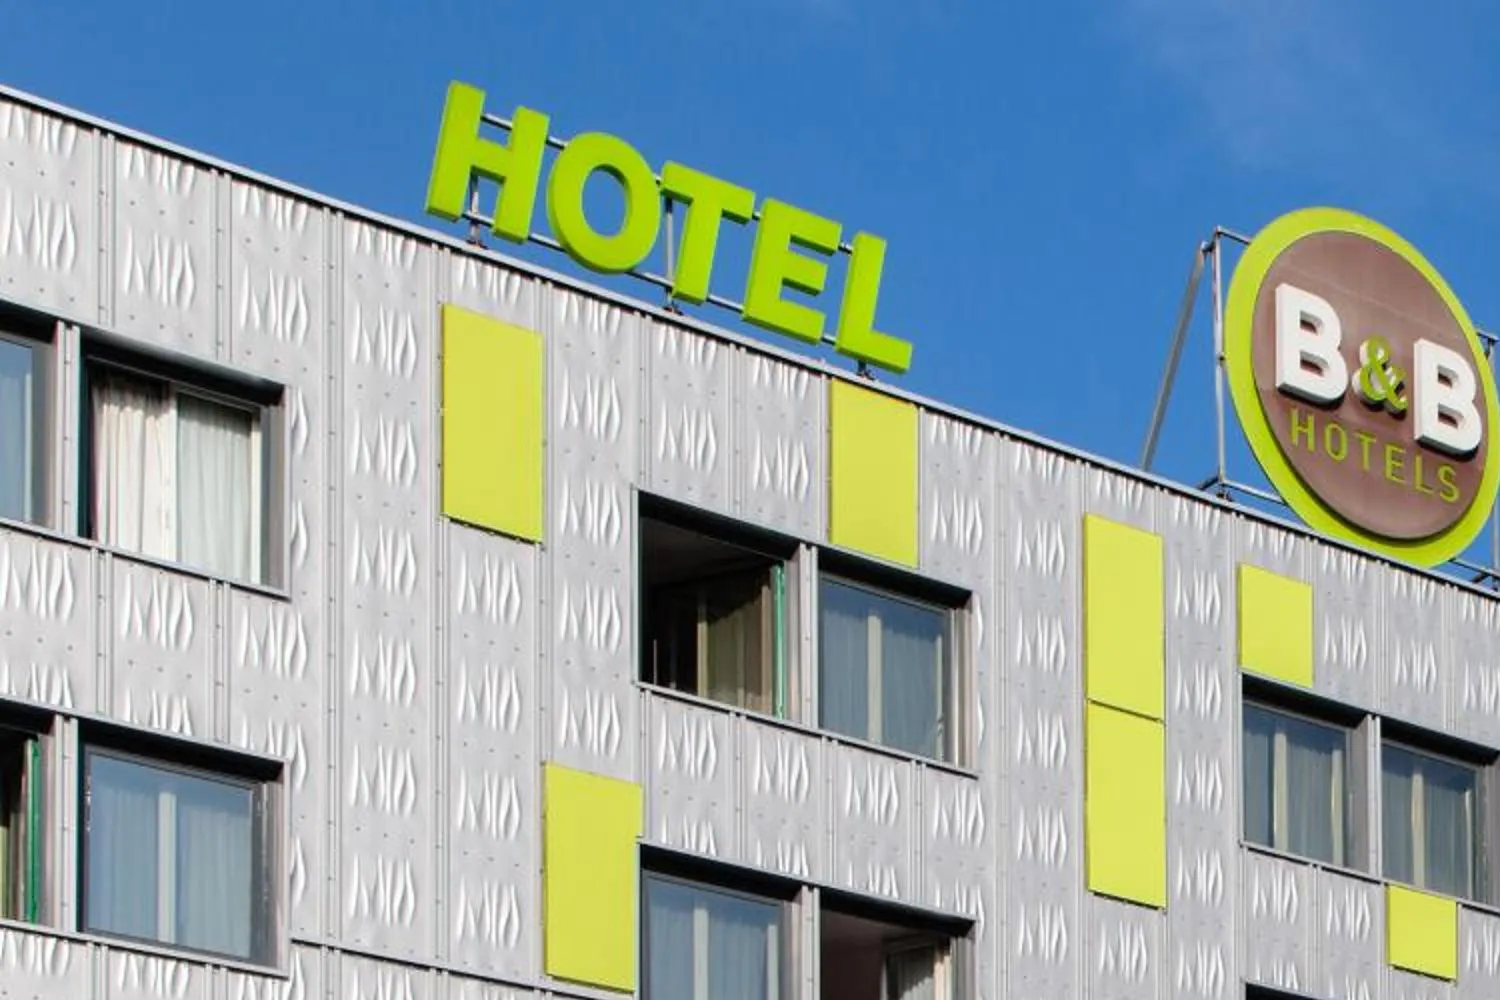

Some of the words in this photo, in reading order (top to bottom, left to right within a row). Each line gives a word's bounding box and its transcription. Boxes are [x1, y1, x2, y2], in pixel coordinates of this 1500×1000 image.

[425, 80, 913, 374] HOTEL
[1275, 283, 1482, 460] B&B
[1288, 406, 1461, 503] HOTELS
